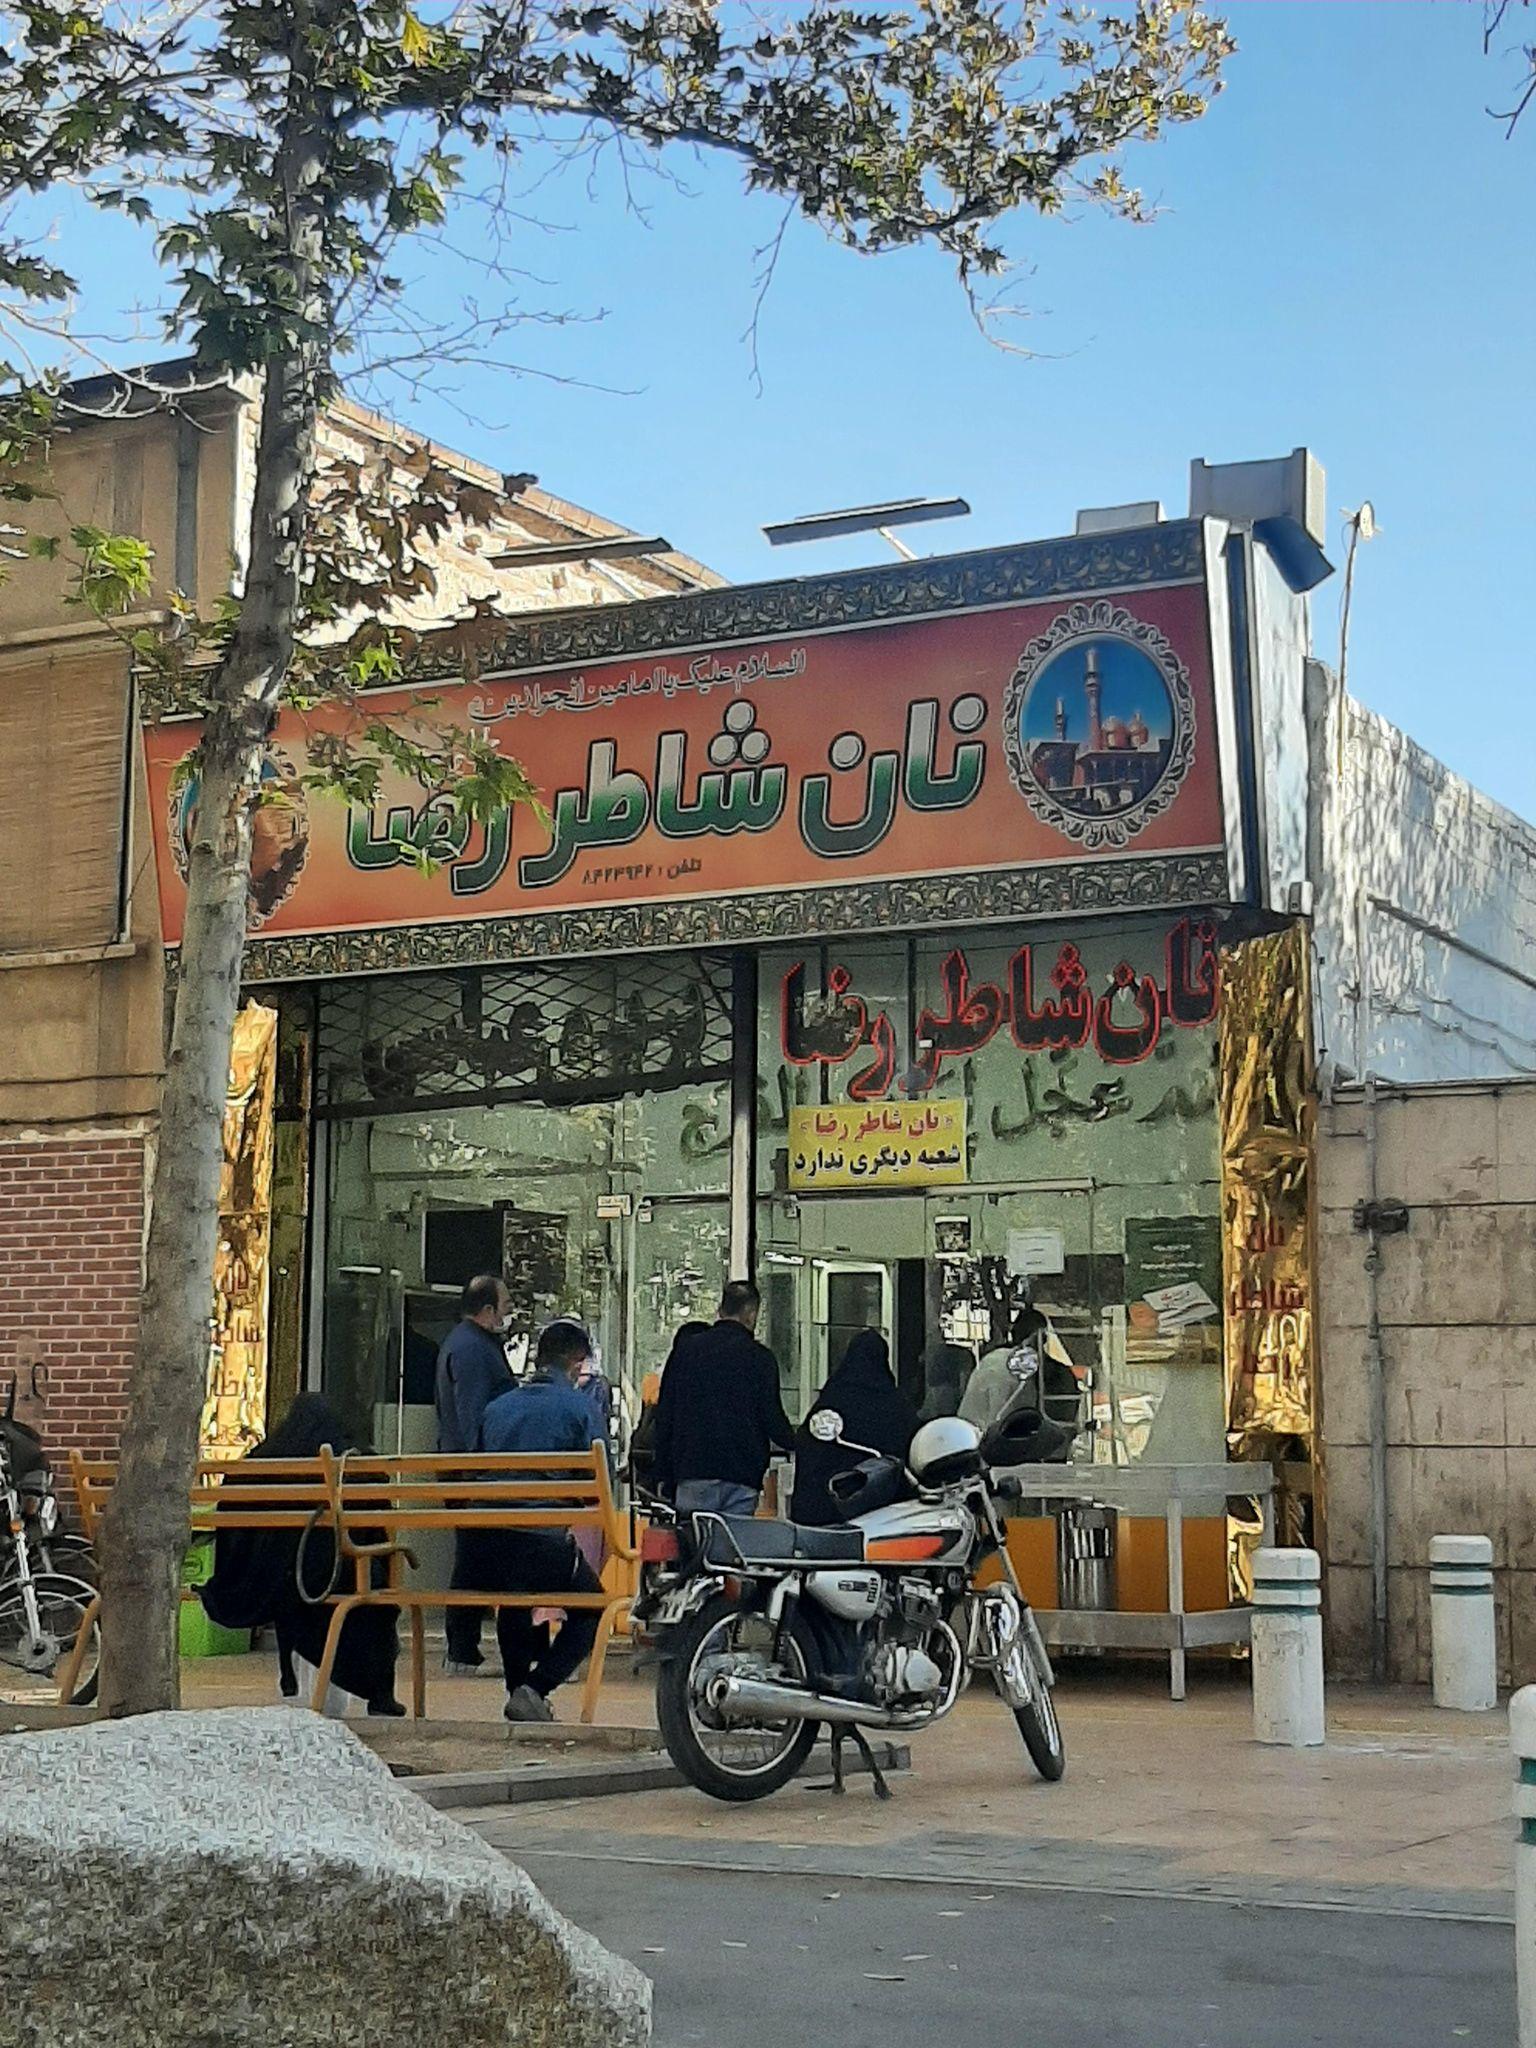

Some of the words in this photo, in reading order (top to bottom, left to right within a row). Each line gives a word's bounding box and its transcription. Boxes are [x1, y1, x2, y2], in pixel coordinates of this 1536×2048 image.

[732, 648, 807, 694] السلام
[519, 699, 788, 888] شاطر
[799, 692, 989, 860] نان
[346, 764, 513, 896] رضا
[1093, 914, 1220, 1064] نان
[780, 961, 896, 1098] رضا
[898, 941, 1093, 1092] شاطر
[815, 1112, 849, 1142] رضا
[854, 1109, 903, 1142] شاطر
[907, 1107, 940, 1138] نان
[794, 1146, 845, 1178] ندارد
[849, 1144, 912, 1176] دیگری
[917, 1143, 962, 1171] شعبه
